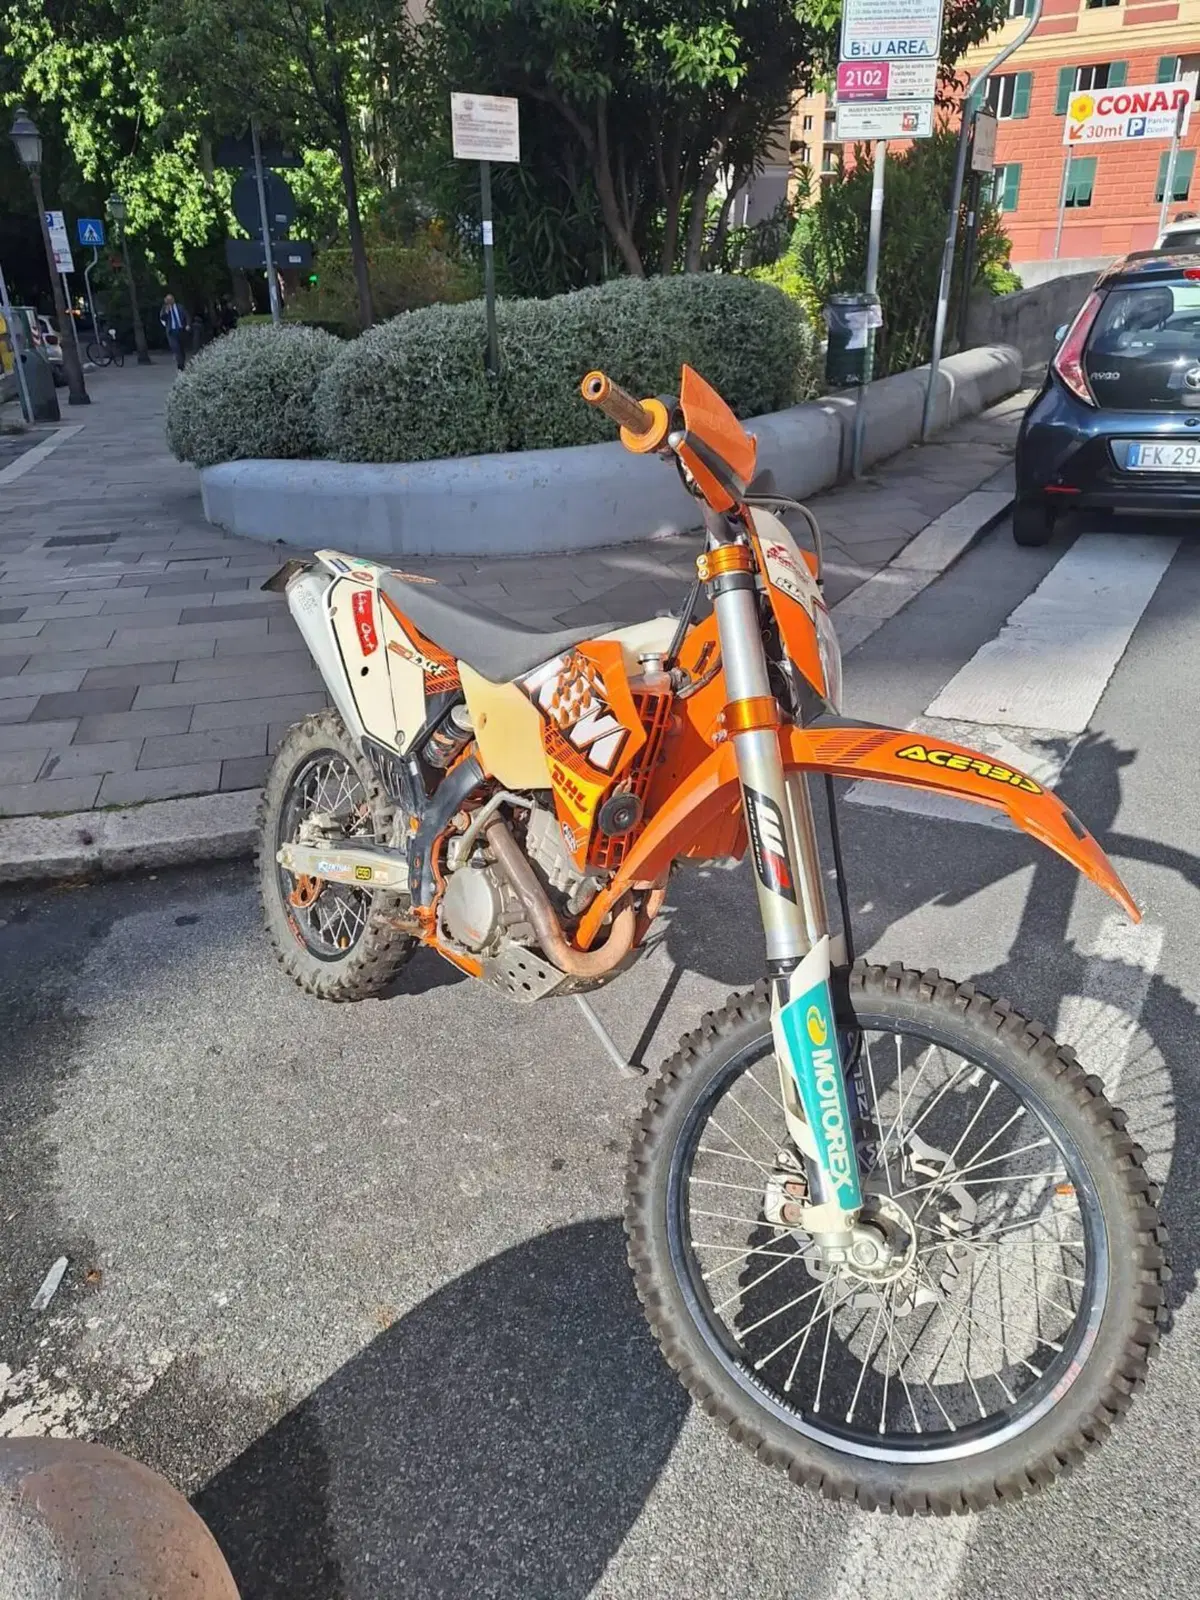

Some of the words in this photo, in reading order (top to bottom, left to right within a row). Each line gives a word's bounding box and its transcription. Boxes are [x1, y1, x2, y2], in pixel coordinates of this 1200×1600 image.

[851, 42, 881, 55] BLU
[886, 40, 929, 55] AREA
[845, 70, 882, 86] 2102
[1097, 89, 1190, 115] CONAD
[1087, 124, 1122, 138] 30mt
[1141, 447, 1164, 465] FK
[1172, 447, 1200, 465] 29
[551, 764, 589, 813] DHL
[811, 1048, 852, 1191] MOTOREX
